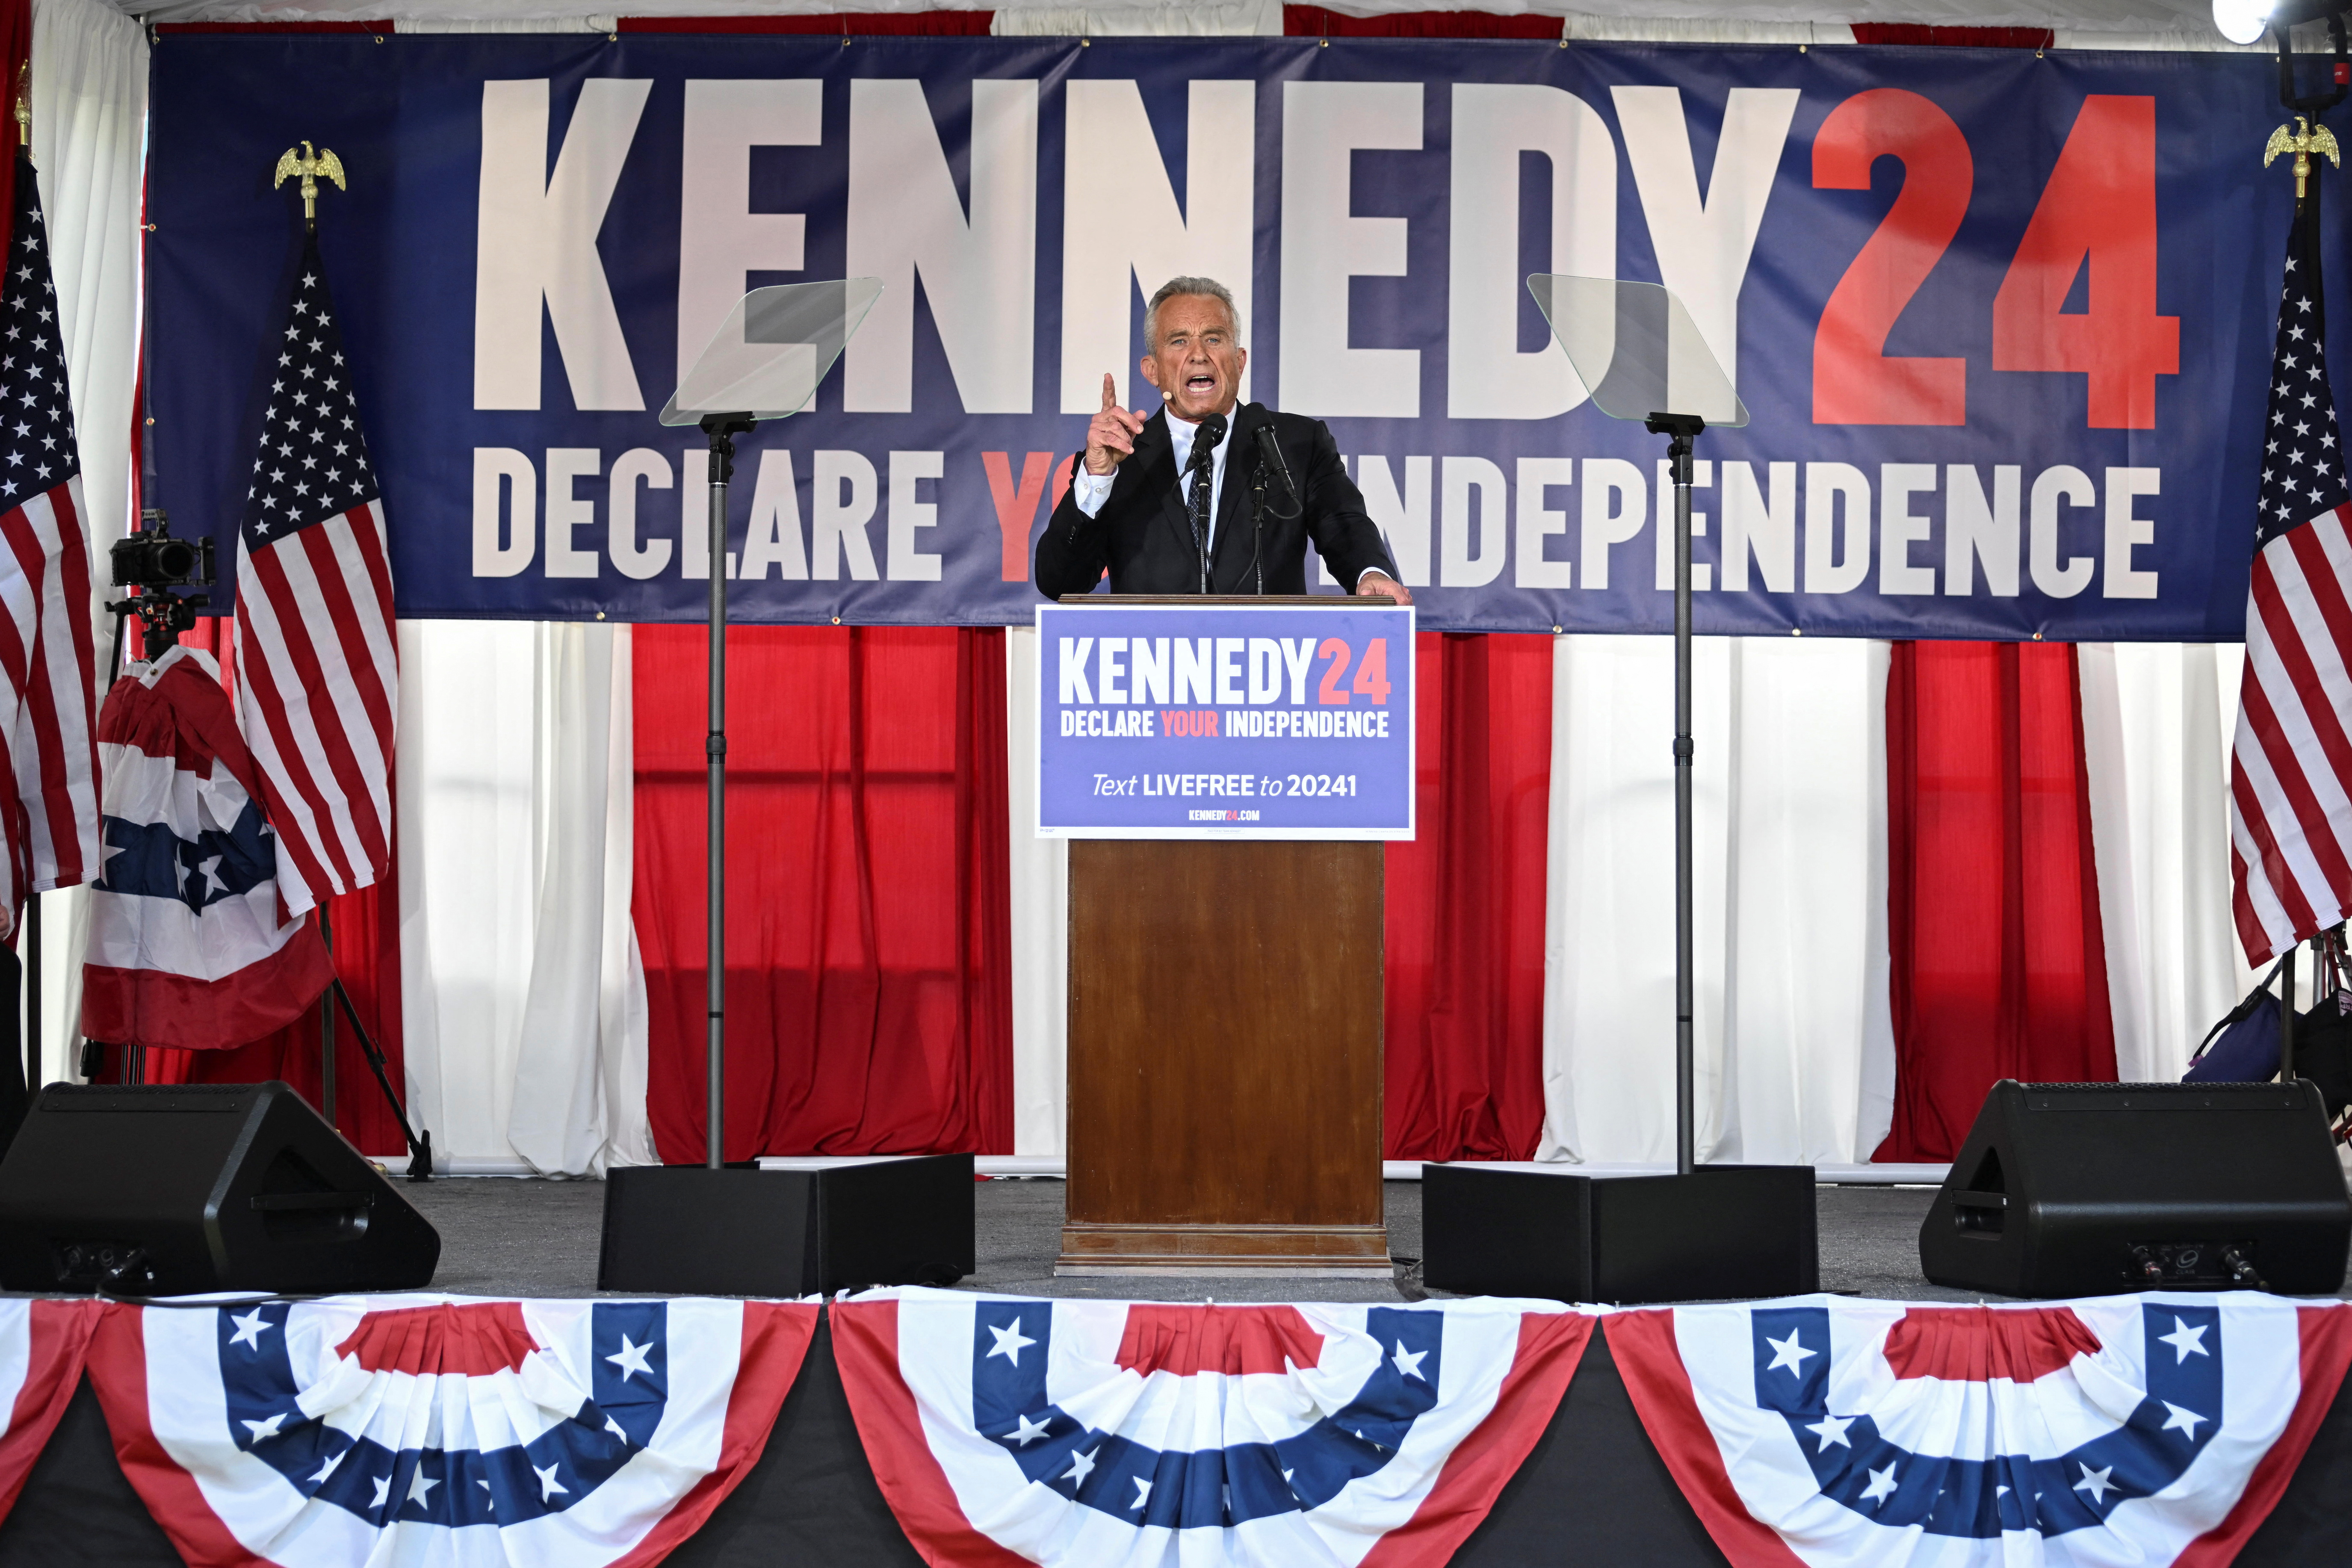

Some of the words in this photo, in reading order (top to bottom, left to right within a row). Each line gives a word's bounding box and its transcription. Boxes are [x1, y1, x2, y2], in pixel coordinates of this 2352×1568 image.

[473, 78, 2180, 429] KENNEDY24
[472, 447, 944, 582] DECLARE
[1319, 454, 2160, 599] NDEPENDENCE
[1059, 637, 1391, 705] KENNEDY24
[1061, 710, 1154, 737] DECLARE
[1161, 710, 1219, 737] YOUR
[1226, 711, 1389, 738] INDEPENDENCE
[1093, 774, 1138, 796] Text
[1143, 774, 1254, 796] LIVEFREE
[1260, 776, 1282, 797] to
[1287, 774, 1356, 797] 20241
[1189, 810, 1260, 821] KENNEDY24.COM
